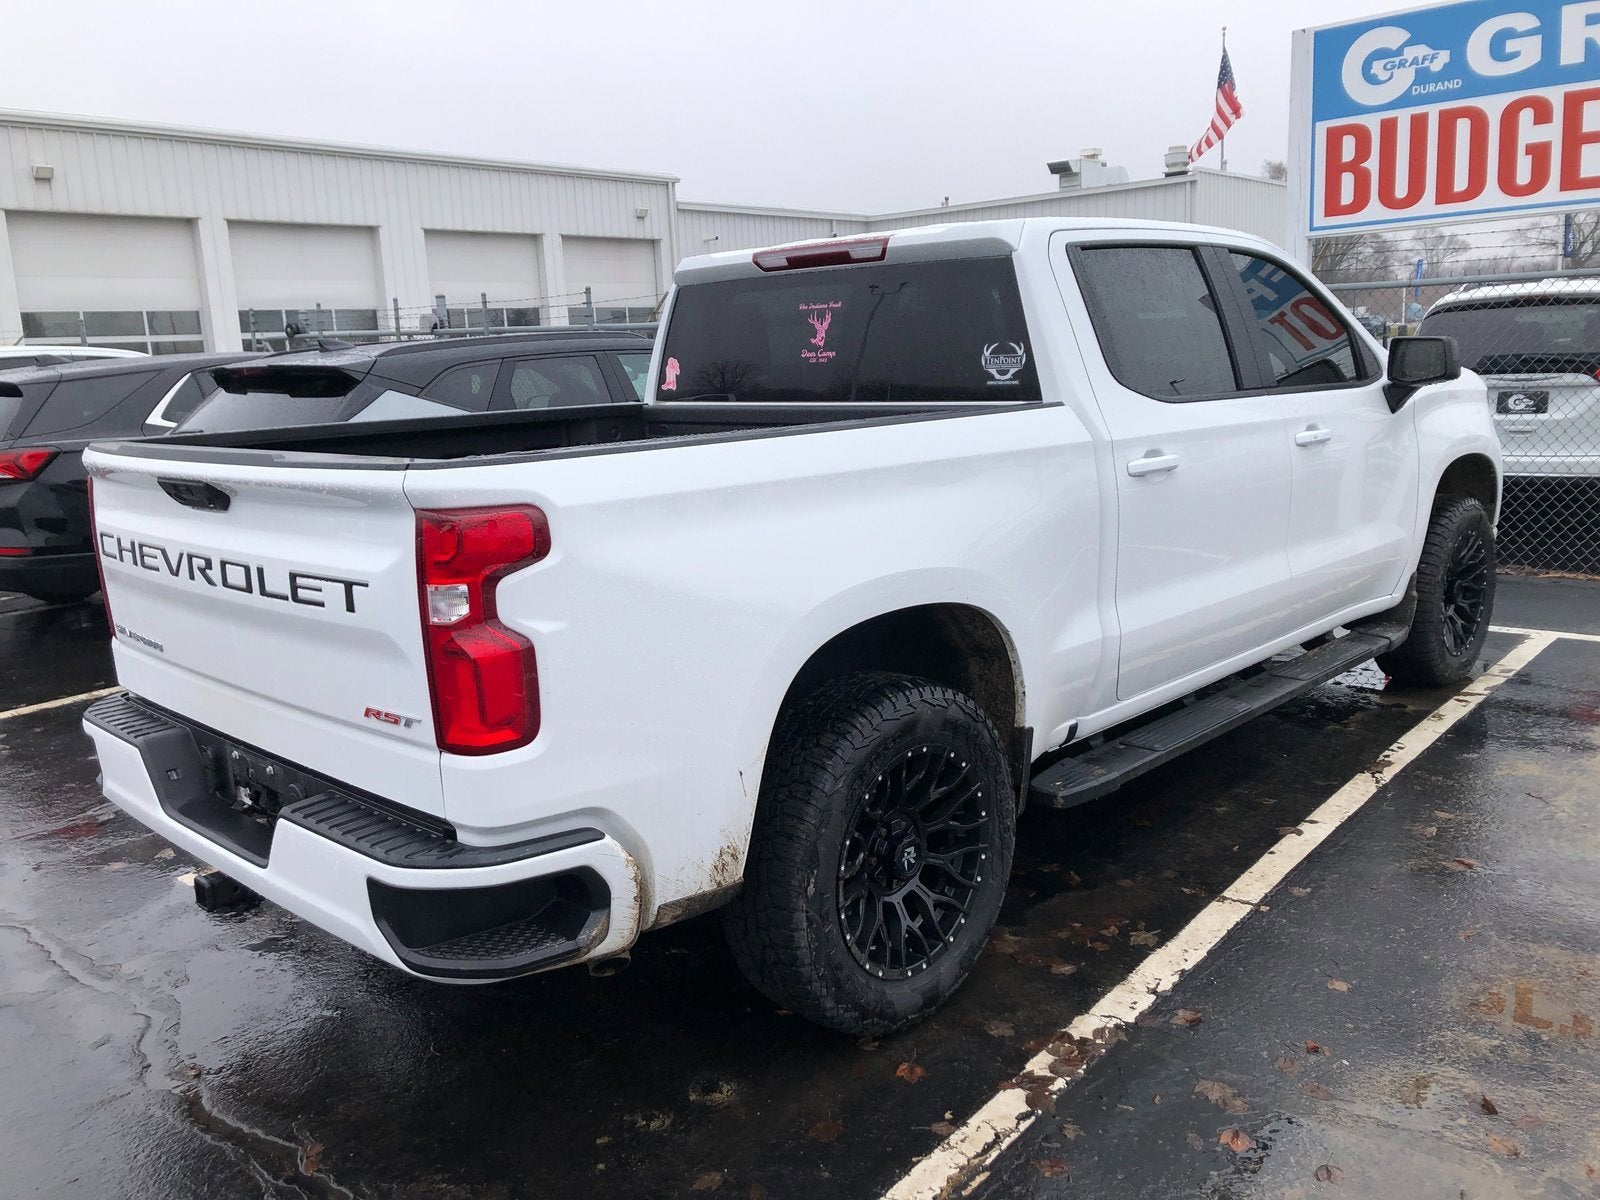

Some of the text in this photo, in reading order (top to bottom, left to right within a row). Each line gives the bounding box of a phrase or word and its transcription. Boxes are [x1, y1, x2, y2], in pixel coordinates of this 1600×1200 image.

[1382, 51, 1440, 72] GRAFF
[1411, 78, 1463, 96] DURAND
[817, 348, 836, 359] Camp
[99, 530, 370, 614] CHEVROLET
[363, 705, 422, 729] RST
